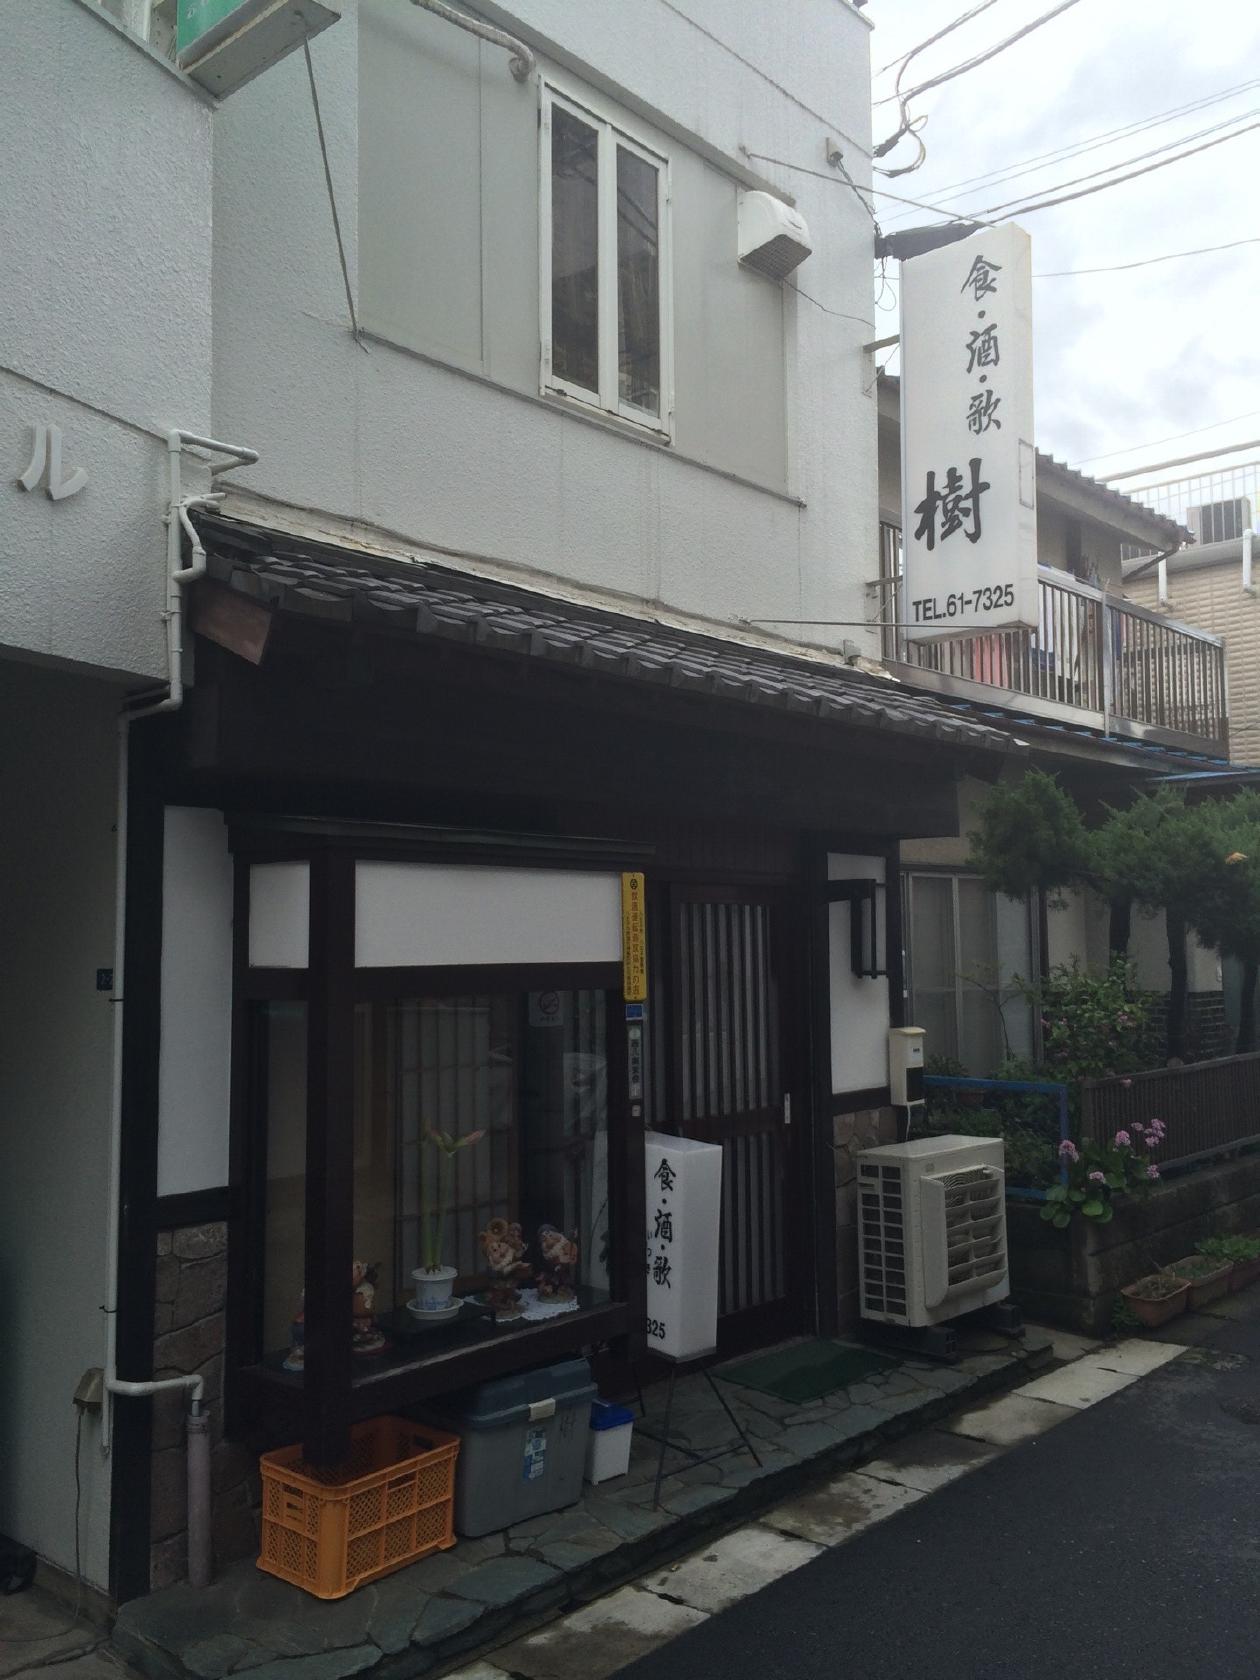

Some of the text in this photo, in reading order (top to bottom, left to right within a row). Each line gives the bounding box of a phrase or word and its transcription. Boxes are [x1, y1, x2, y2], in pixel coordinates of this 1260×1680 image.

[960, 254, 1002, 436] 食・酒・歌
[913, 457, 990, 551] 樹
[912, 583, 1015, 624] TEL.61-7325
